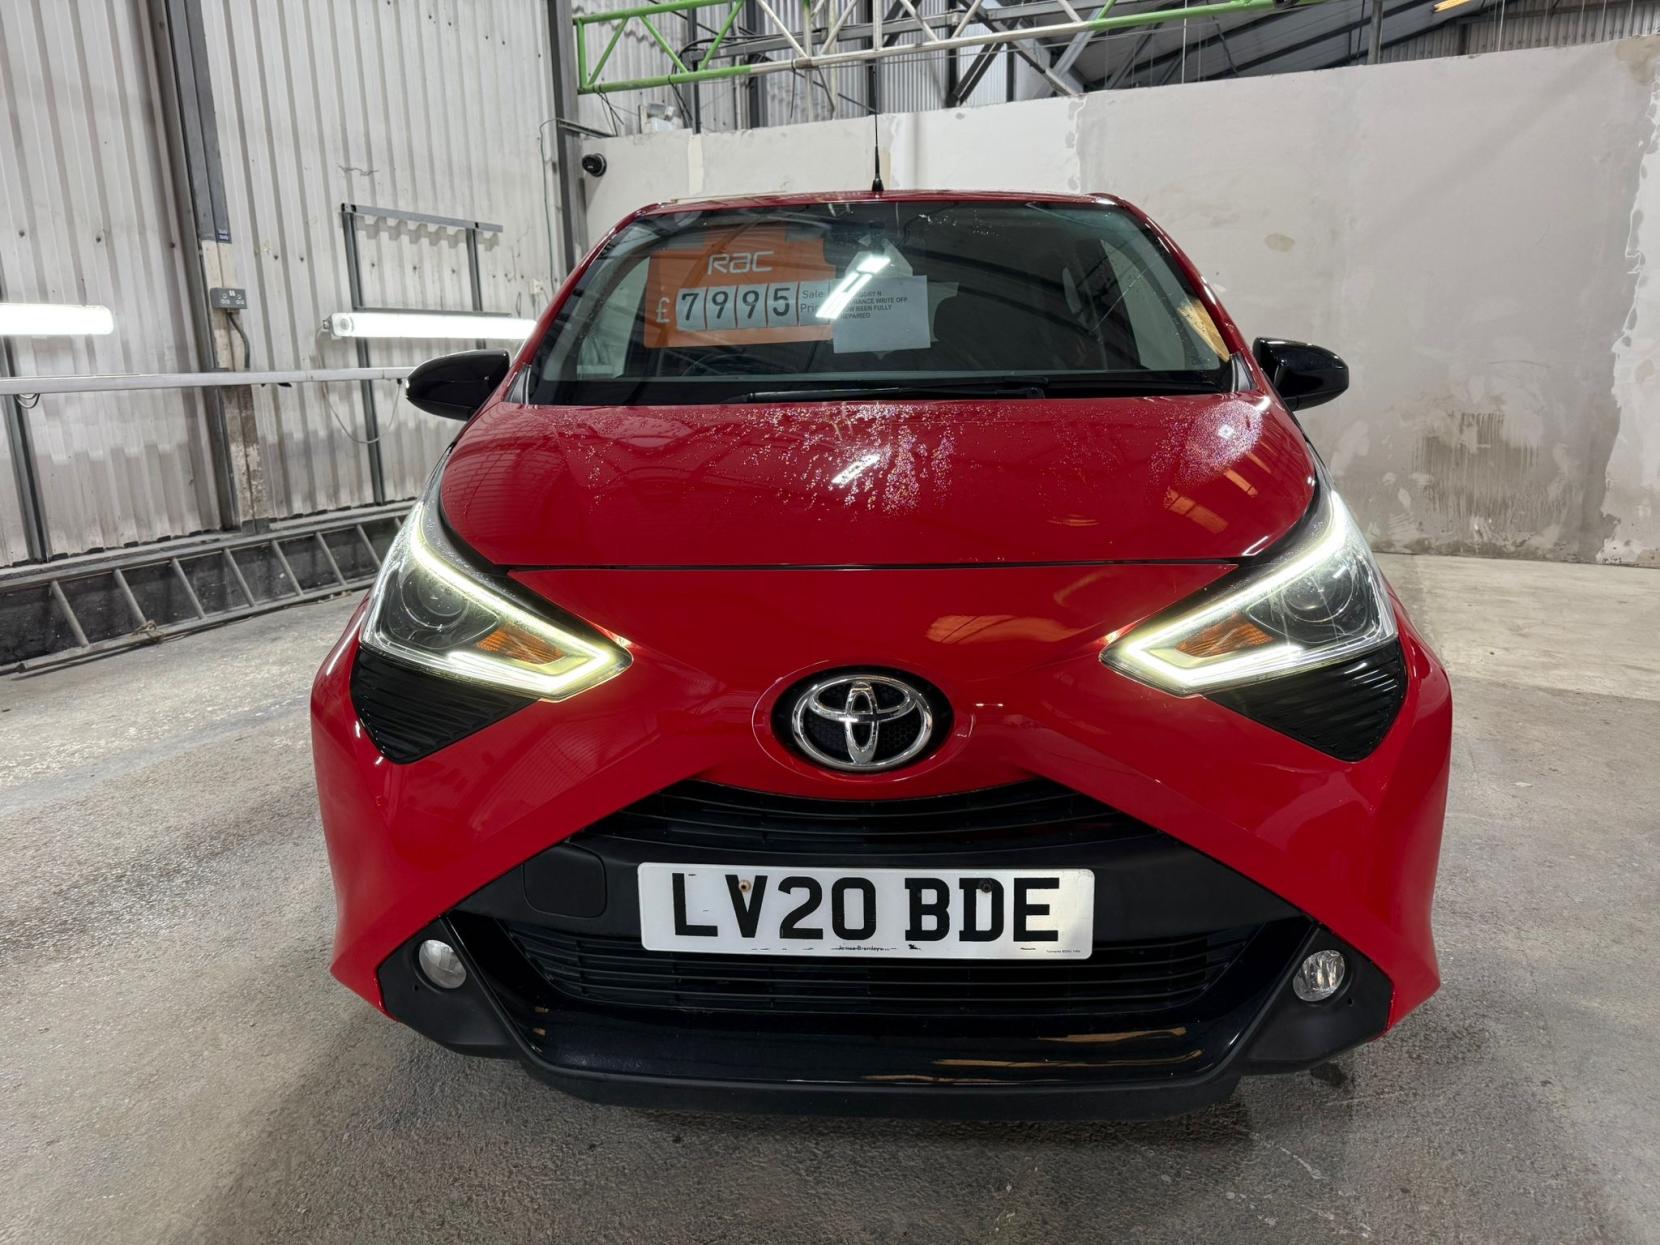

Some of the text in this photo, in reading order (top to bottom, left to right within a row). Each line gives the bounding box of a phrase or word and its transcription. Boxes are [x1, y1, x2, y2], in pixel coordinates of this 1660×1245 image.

[656, 288, 791, 324] £ 7995
[802, 290, 824, 299] Sale
[801, 303, 818, 313] Pri
[671, 873, 1060, 942] LV20 BDE
